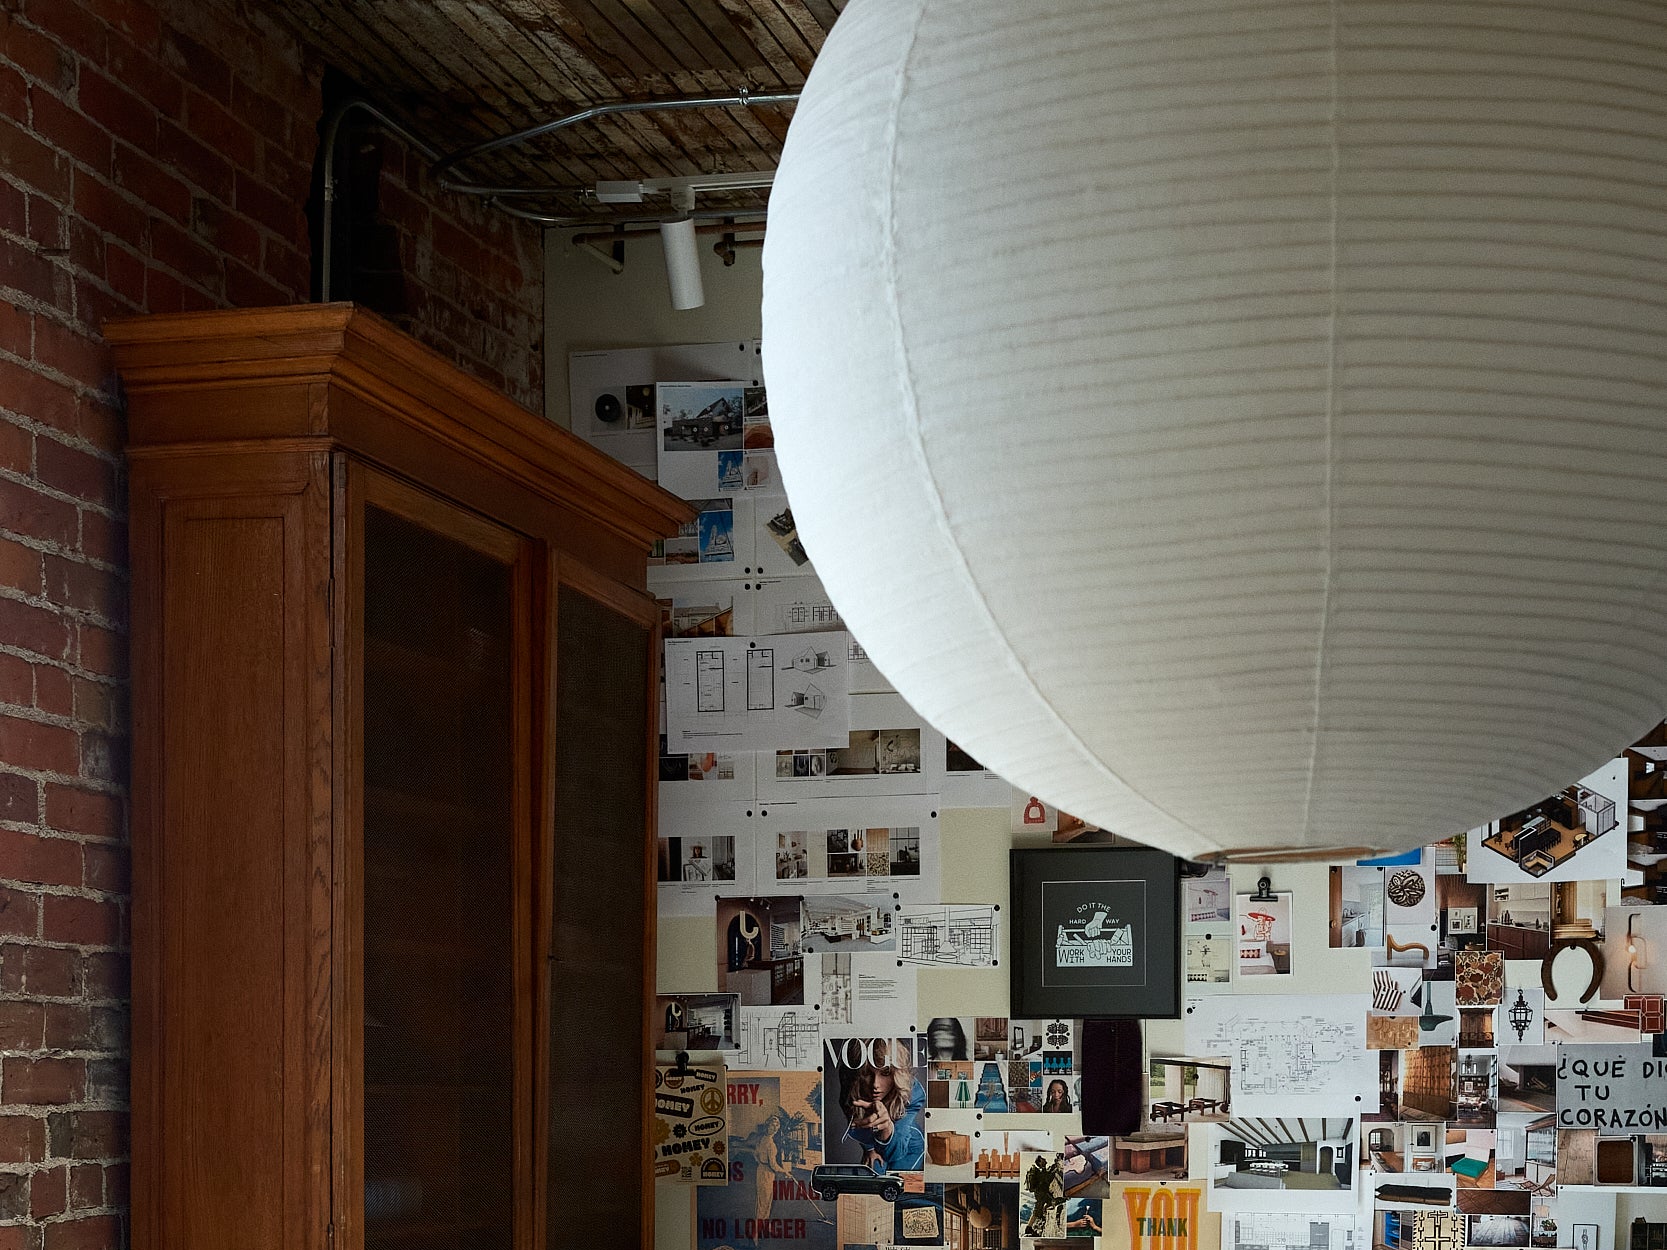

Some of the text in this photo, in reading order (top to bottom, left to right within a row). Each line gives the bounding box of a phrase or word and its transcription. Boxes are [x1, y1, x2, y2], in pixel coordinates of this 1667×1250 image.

[1076, 904, 1088, 913] DO
[1098, 903, 1111, 912] THE
[823, 1037, 928, 1070] VOGUE
[1643, 1060, 1667, 1079] DI
[727, 1083, 764, 1107] RRY,
[1574, 1084, 1610, 1101] TU
[656, 1098, 690, 1113] ONEY
[1560, 1103, 1667, 1130] CORAZÓN
[661, 1137, 710, 1156] HONEY
[702, 1218, 806, 1240] NO LONGER
[1136, 1217, 1188, 1237] THANK
